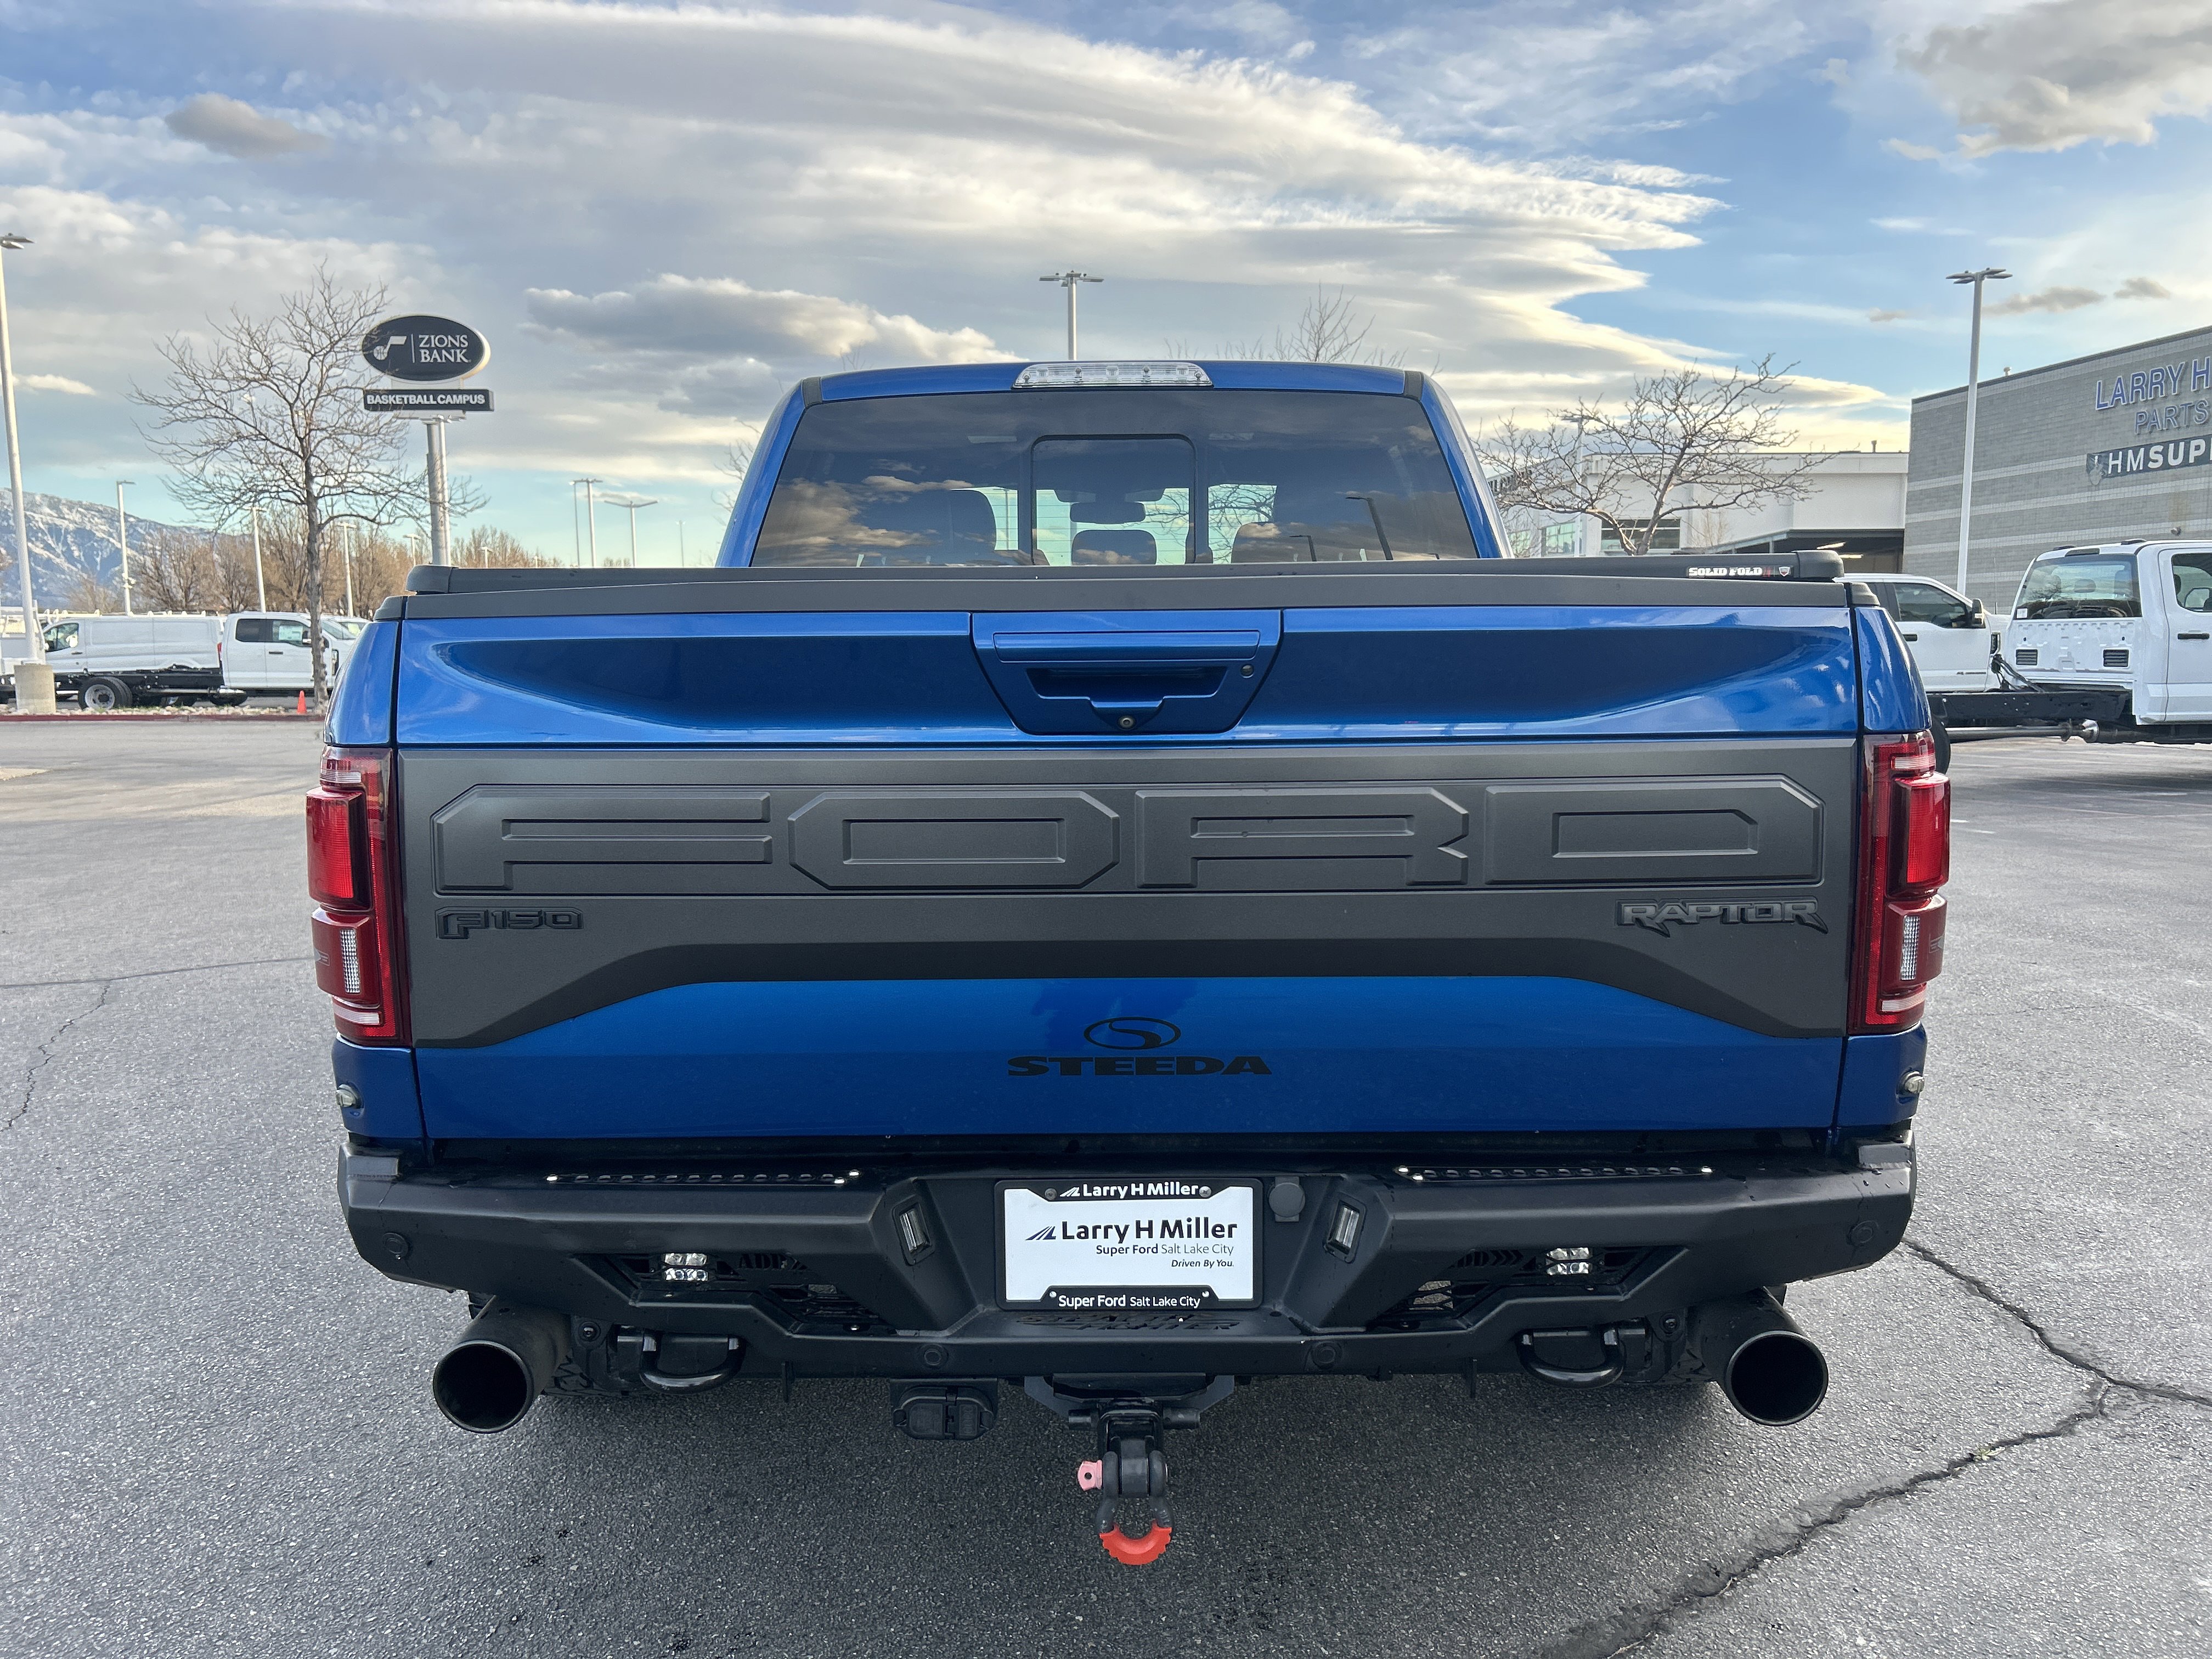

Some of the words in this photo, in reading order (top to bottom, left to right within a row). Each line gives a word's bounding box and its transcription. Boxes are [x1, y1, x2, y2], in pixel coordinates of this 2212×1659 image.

[419, 334, 469, 348] ZIONS
[419, 349, 470, 363] BANK
[2095, 361, 2186, 410] LARRY
[2191, 356, 2211, 392] H
[366, 394, 438, 405] BASKETBALL
[437, 394, 486, 405] CAMPUS
[2134, 399, 2209, 435] PARTS
[2093, 437, 2212, 475] HMSUP
[1689, 567, 1728, 576] SOLID
[1729, 567, 1763, 576] FOLD
[435, 776, 1824, 890] FORD
[437, 909, 583, 940] F150
[1620, 900, 1828, 938] RAPTOR
[1007, 1055, 1272, 1076] STEEDA
[1083, 1183, 1128, 1199] Larry
[1131, 1183, 1144, 1195] H
[1147, 1181, 1199, 1196] Miller
[1062, 1221, 1130, 1244] Larry
[1136, 1220, 1153, 1239] H
[1160, 1217, 1238, 1239] Miller
[1096, 1245, 1130, 1256] Super
[1132, 1243, 1158, 1254] Ford
[1161, 1243, 1181, 1254] Salt
[1184, 1243, 1209, 1254] Lake
[1212, 1244, 1234, 1256] City
[1171, 1259, 1200, 1267] Driven
[1203, 1260, 1215, 1268] By
[1058, 1295, 1095, 1310] Super
[1097, 1294, 1126, 1306] Ford
[1130, 1296, 1150, 1307] Salt
[1153, 1296, 1177, 1307] Lake
[1180, 1296, 1200, 1309] City
